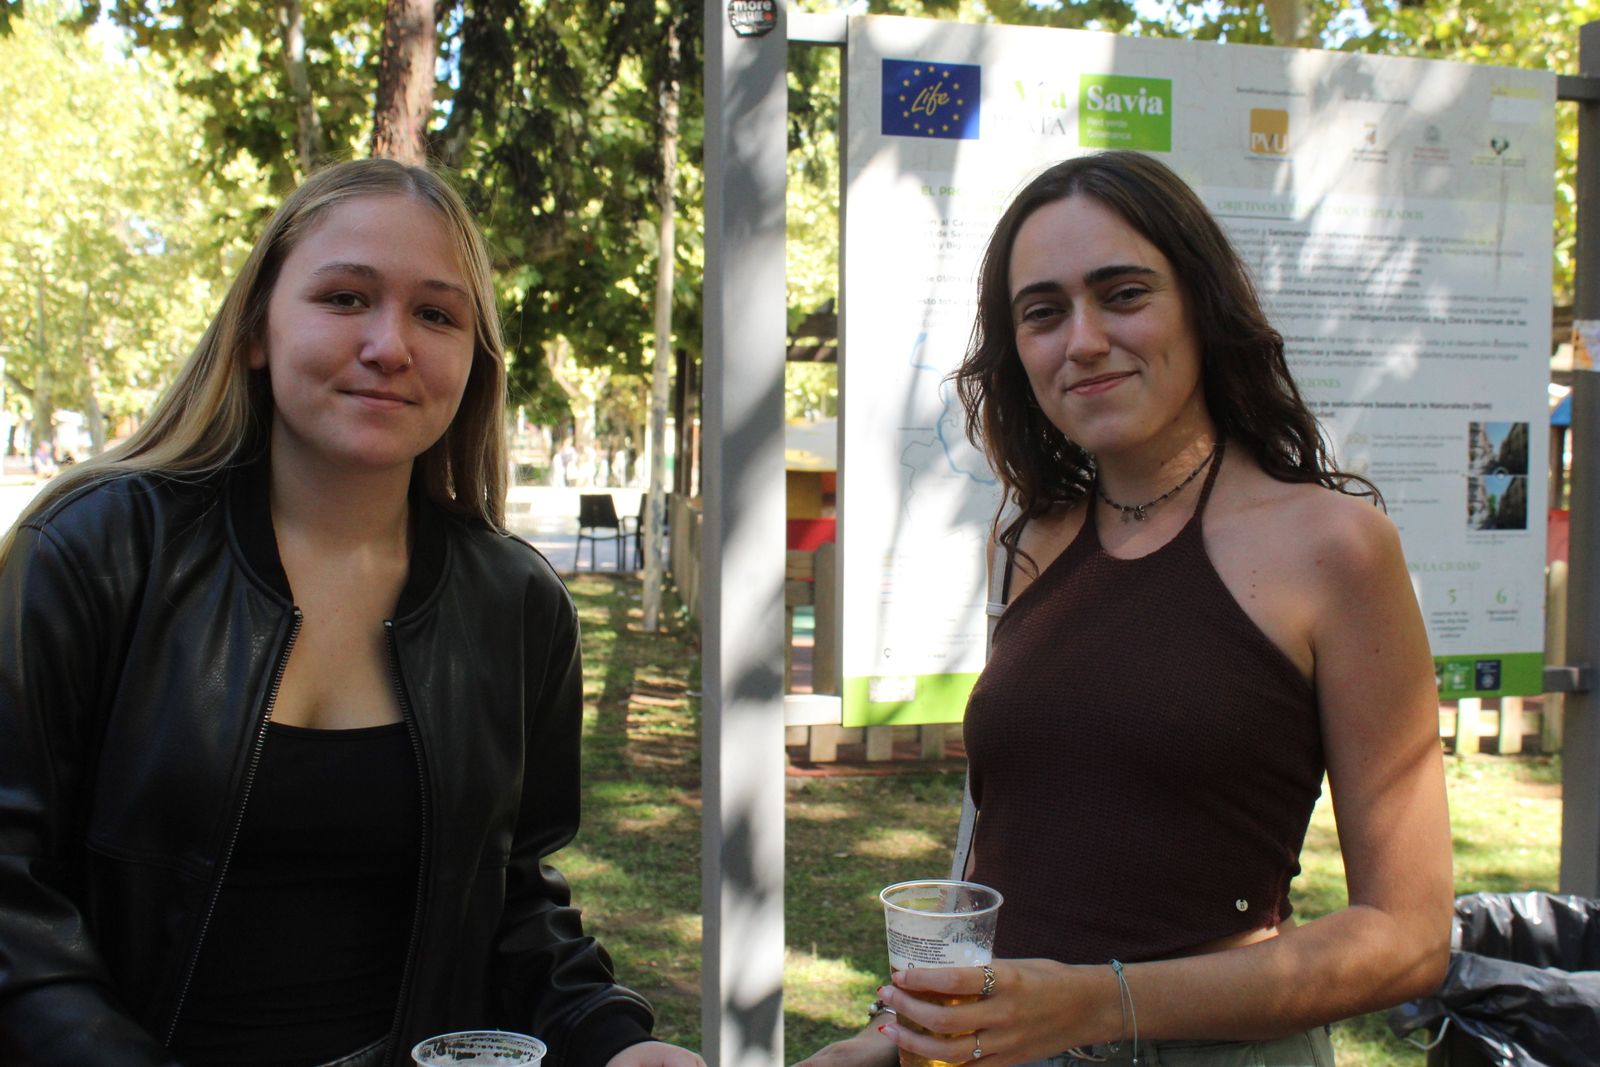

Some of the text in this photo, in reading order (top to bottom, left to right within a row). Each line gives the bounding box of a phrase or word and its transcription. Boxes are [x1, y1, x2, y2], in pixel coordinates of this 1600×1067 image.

[733, 1, 772, 11] more
[911, 81, 950, 116] Life
[1087, 85, 1164, 116] Savia
[1251, 133, 1288, 152] PVU
[921, 185, 935, 196] EL
[1440, 561, 1480, 572] CIUDAD
[1447, 588, 1457, 605] 5
[1496, 587, 1508, 604] 6
